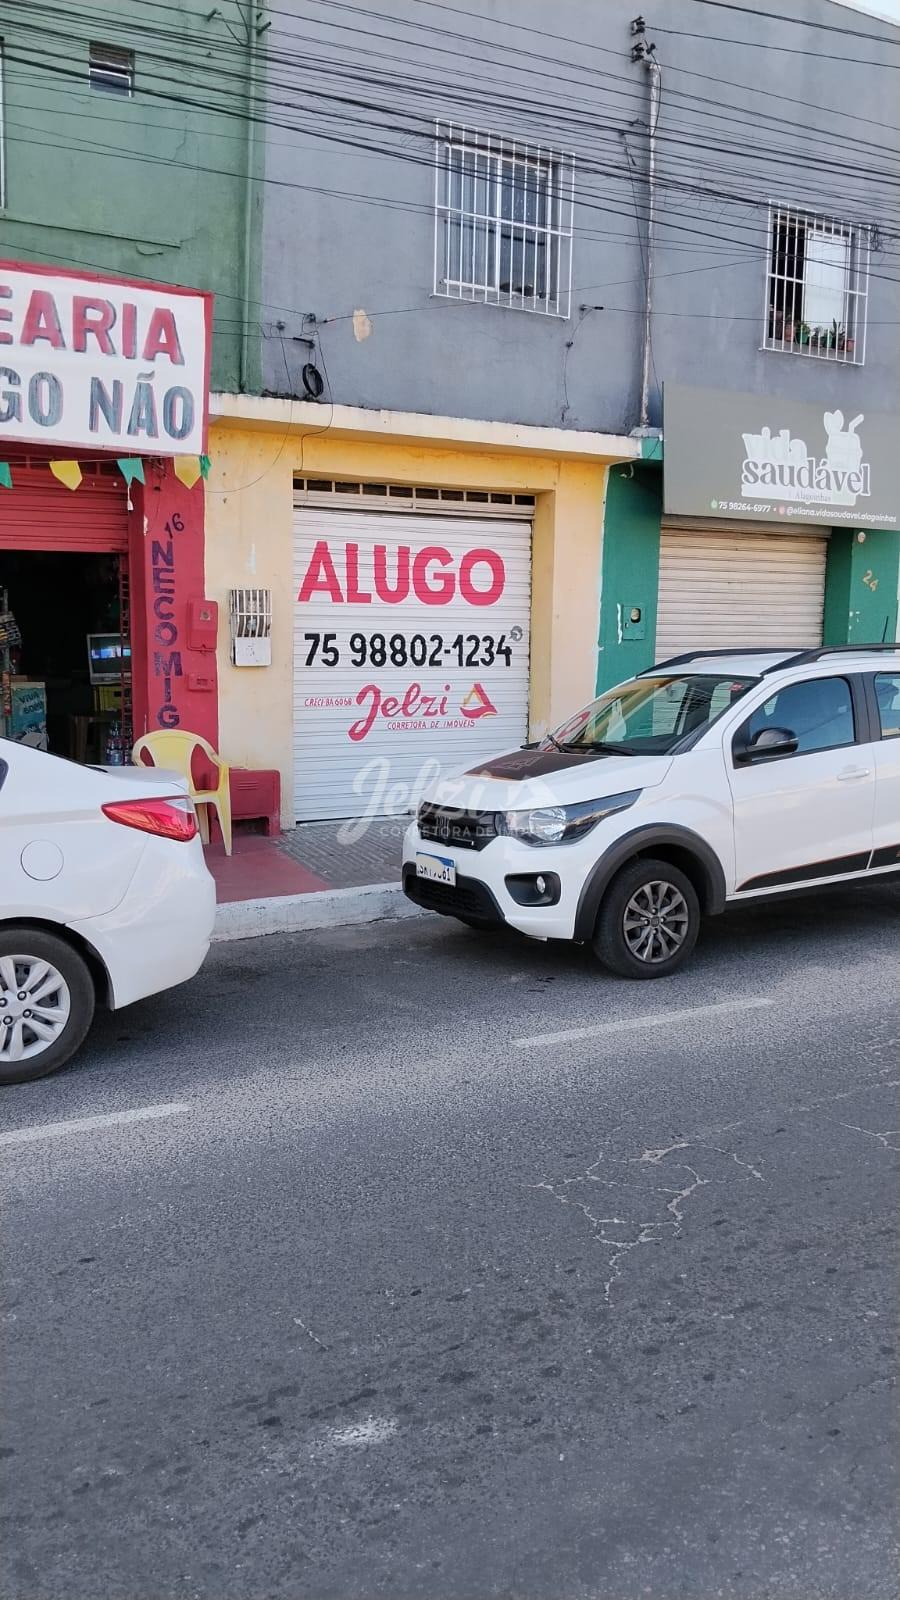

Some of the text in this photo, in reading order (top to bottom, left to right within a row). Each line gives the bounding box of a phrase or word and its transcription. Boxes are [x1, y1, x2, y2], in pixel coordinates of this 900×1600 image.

[89, 371, 194, 440] NÃO
[743, 458, 870, 495] saudável
[164, 512, 185, 539] 16
[297, 540, 506, 606] ALUGO
[304, 633, 512, 667] 75 98802-1234
[348, 682, 451, 742] Jelzi
[387, 720, 427, 730] CORRETORA
[430, 720, 440, 729] DE
